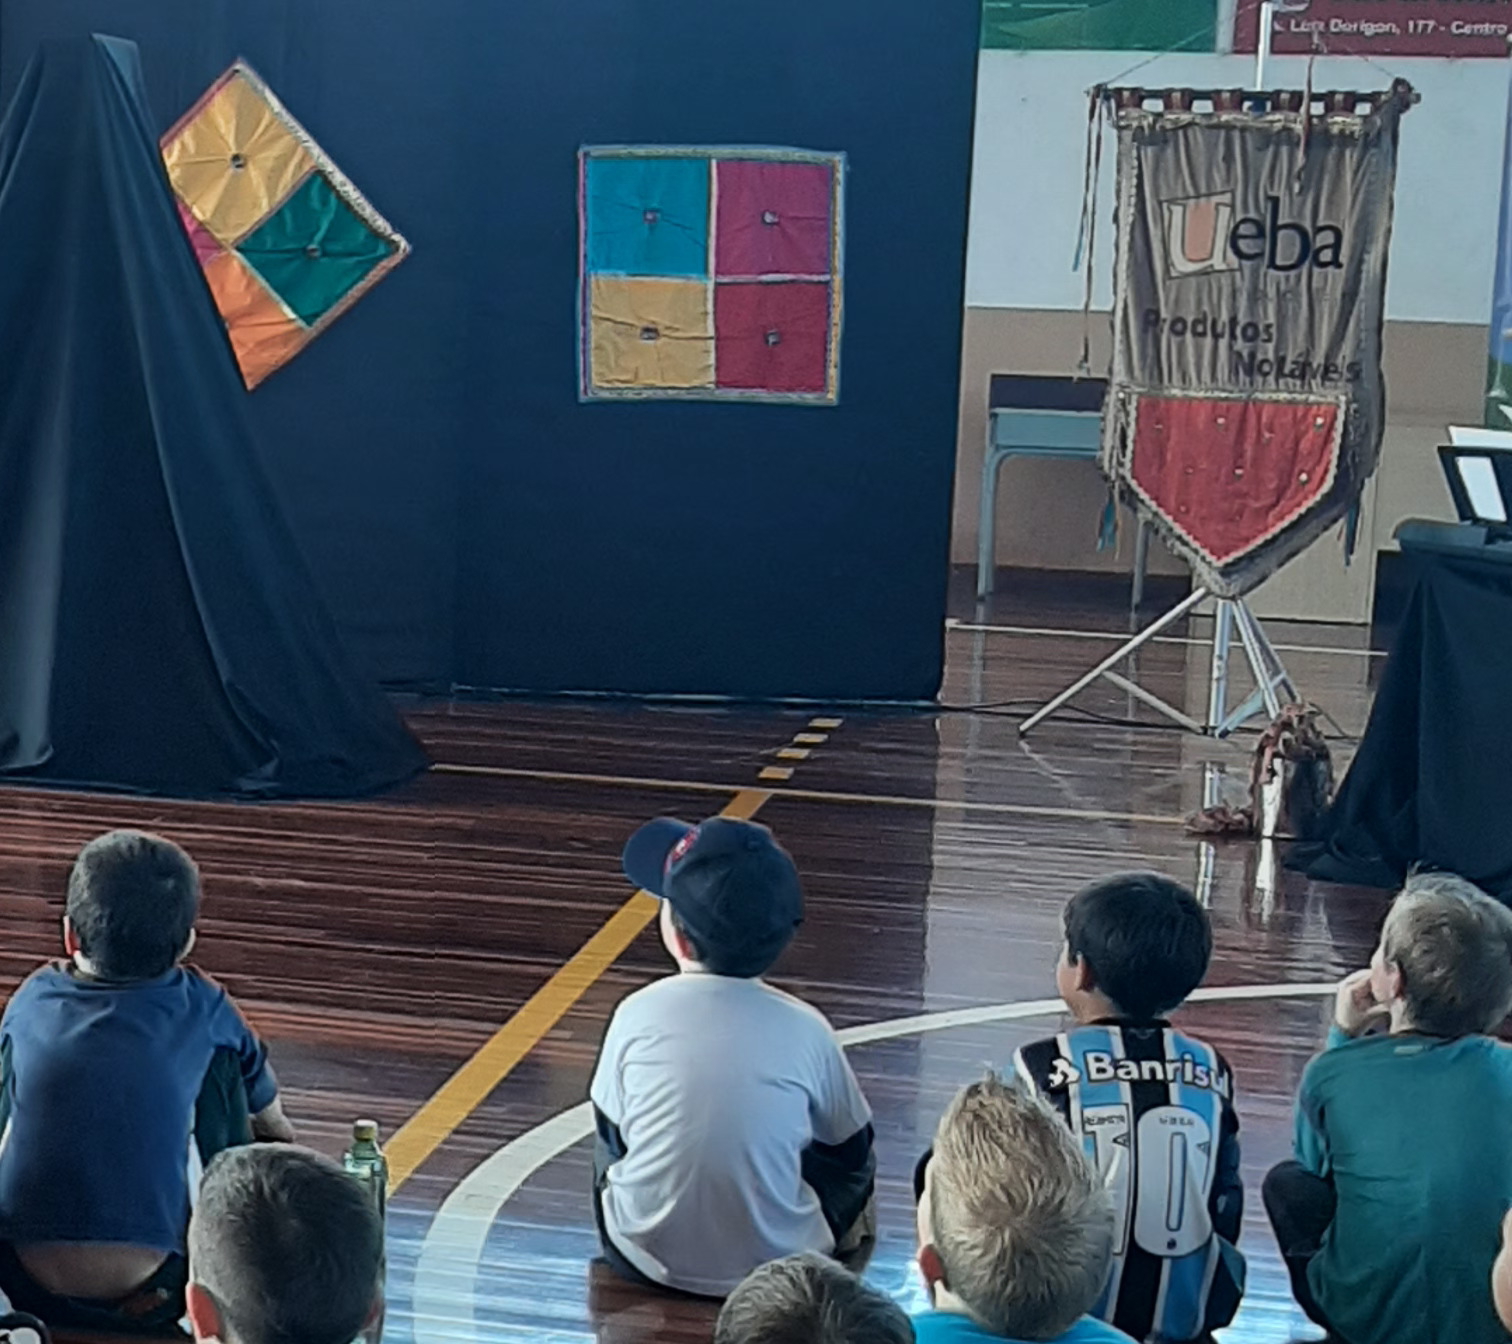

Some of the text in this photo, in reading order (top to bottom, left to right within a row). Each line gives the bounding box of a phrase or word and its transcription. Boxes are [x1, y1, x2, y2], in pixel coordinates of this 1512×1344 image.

[1407, 20, 1435, 33] 177
[1143, 309, 1273, 344] Produtos
[1086, 1050, 1229, 1099] Banrisul
[1082, 1103, 1212, 1257] 10
